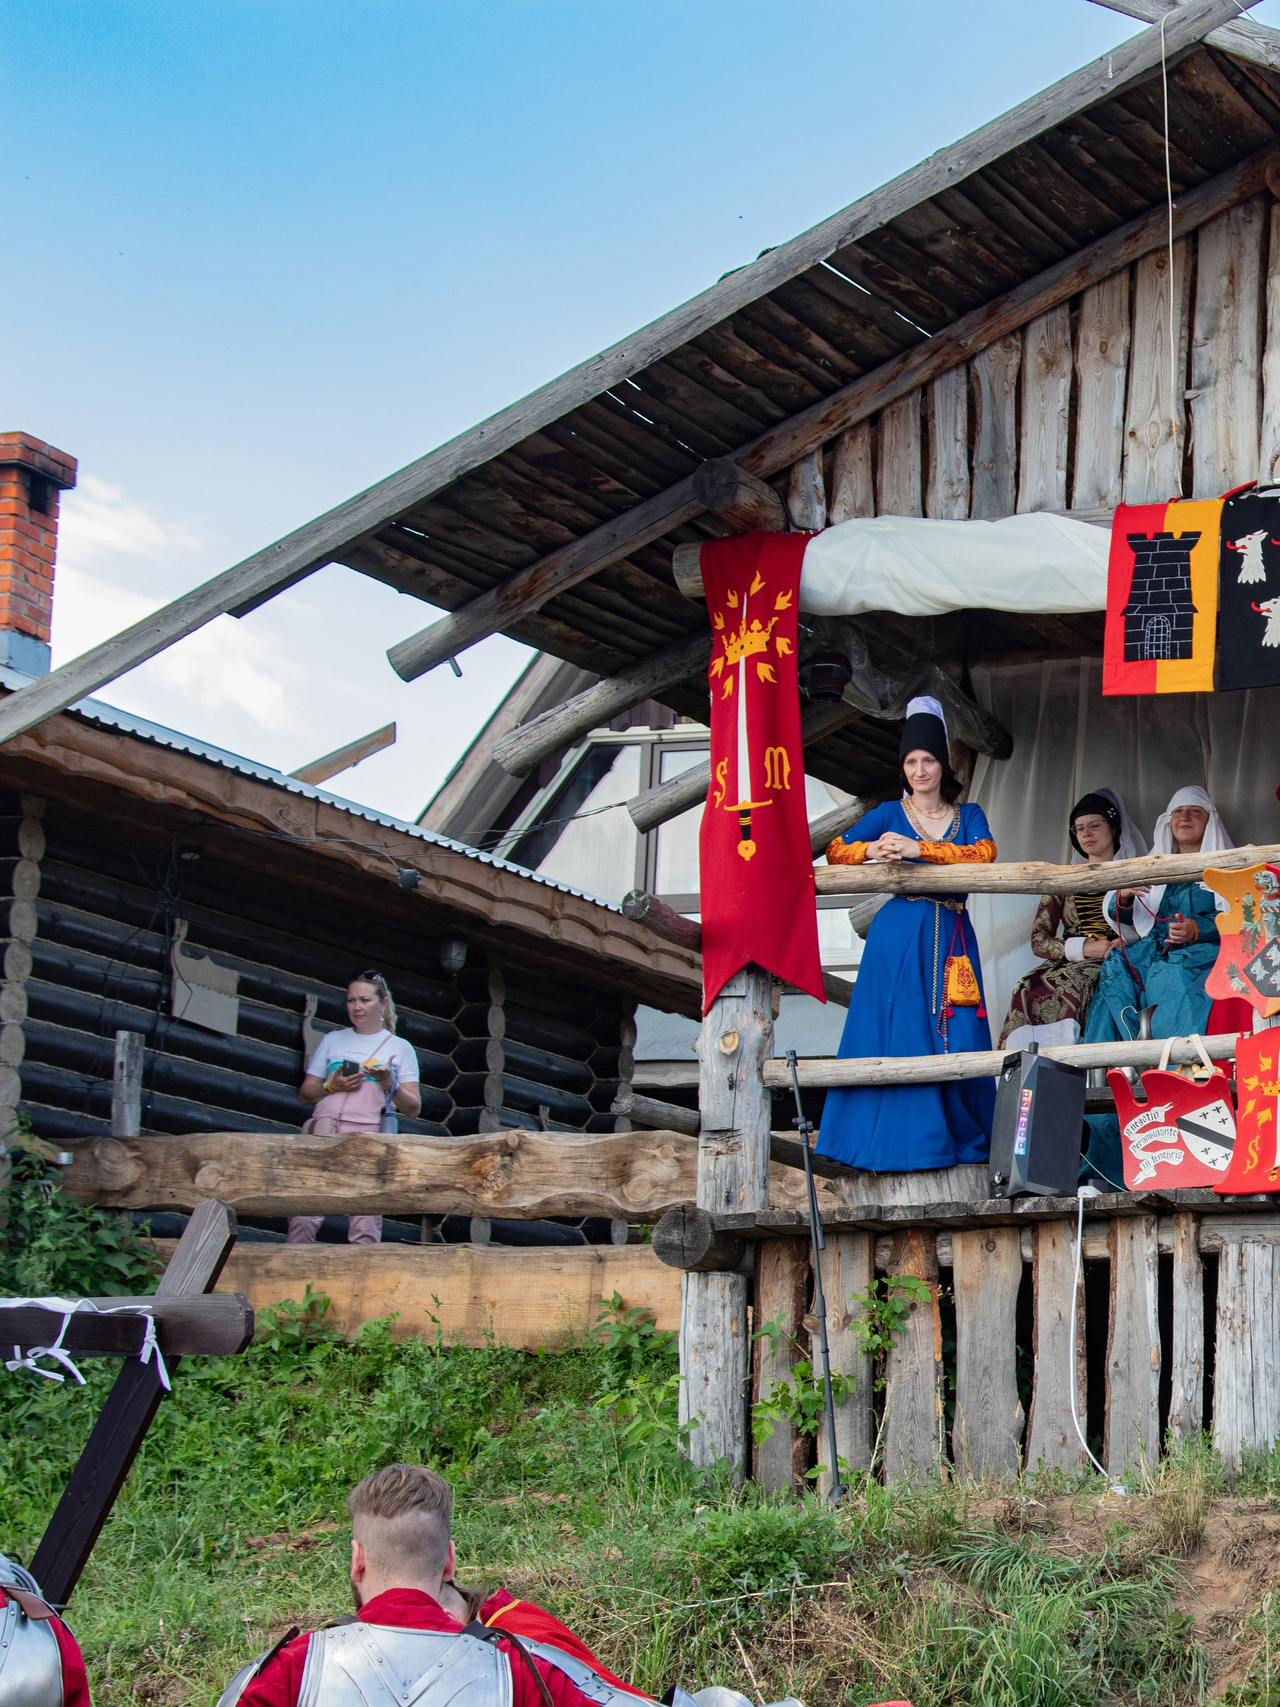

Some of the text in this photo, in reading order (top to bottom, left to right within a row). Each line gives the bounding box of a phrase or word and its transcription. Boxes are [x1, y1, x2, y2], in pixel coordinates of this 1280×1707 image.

[713, 746, 791, 809] S M
[1242, 1135, 1261, 1174] S
